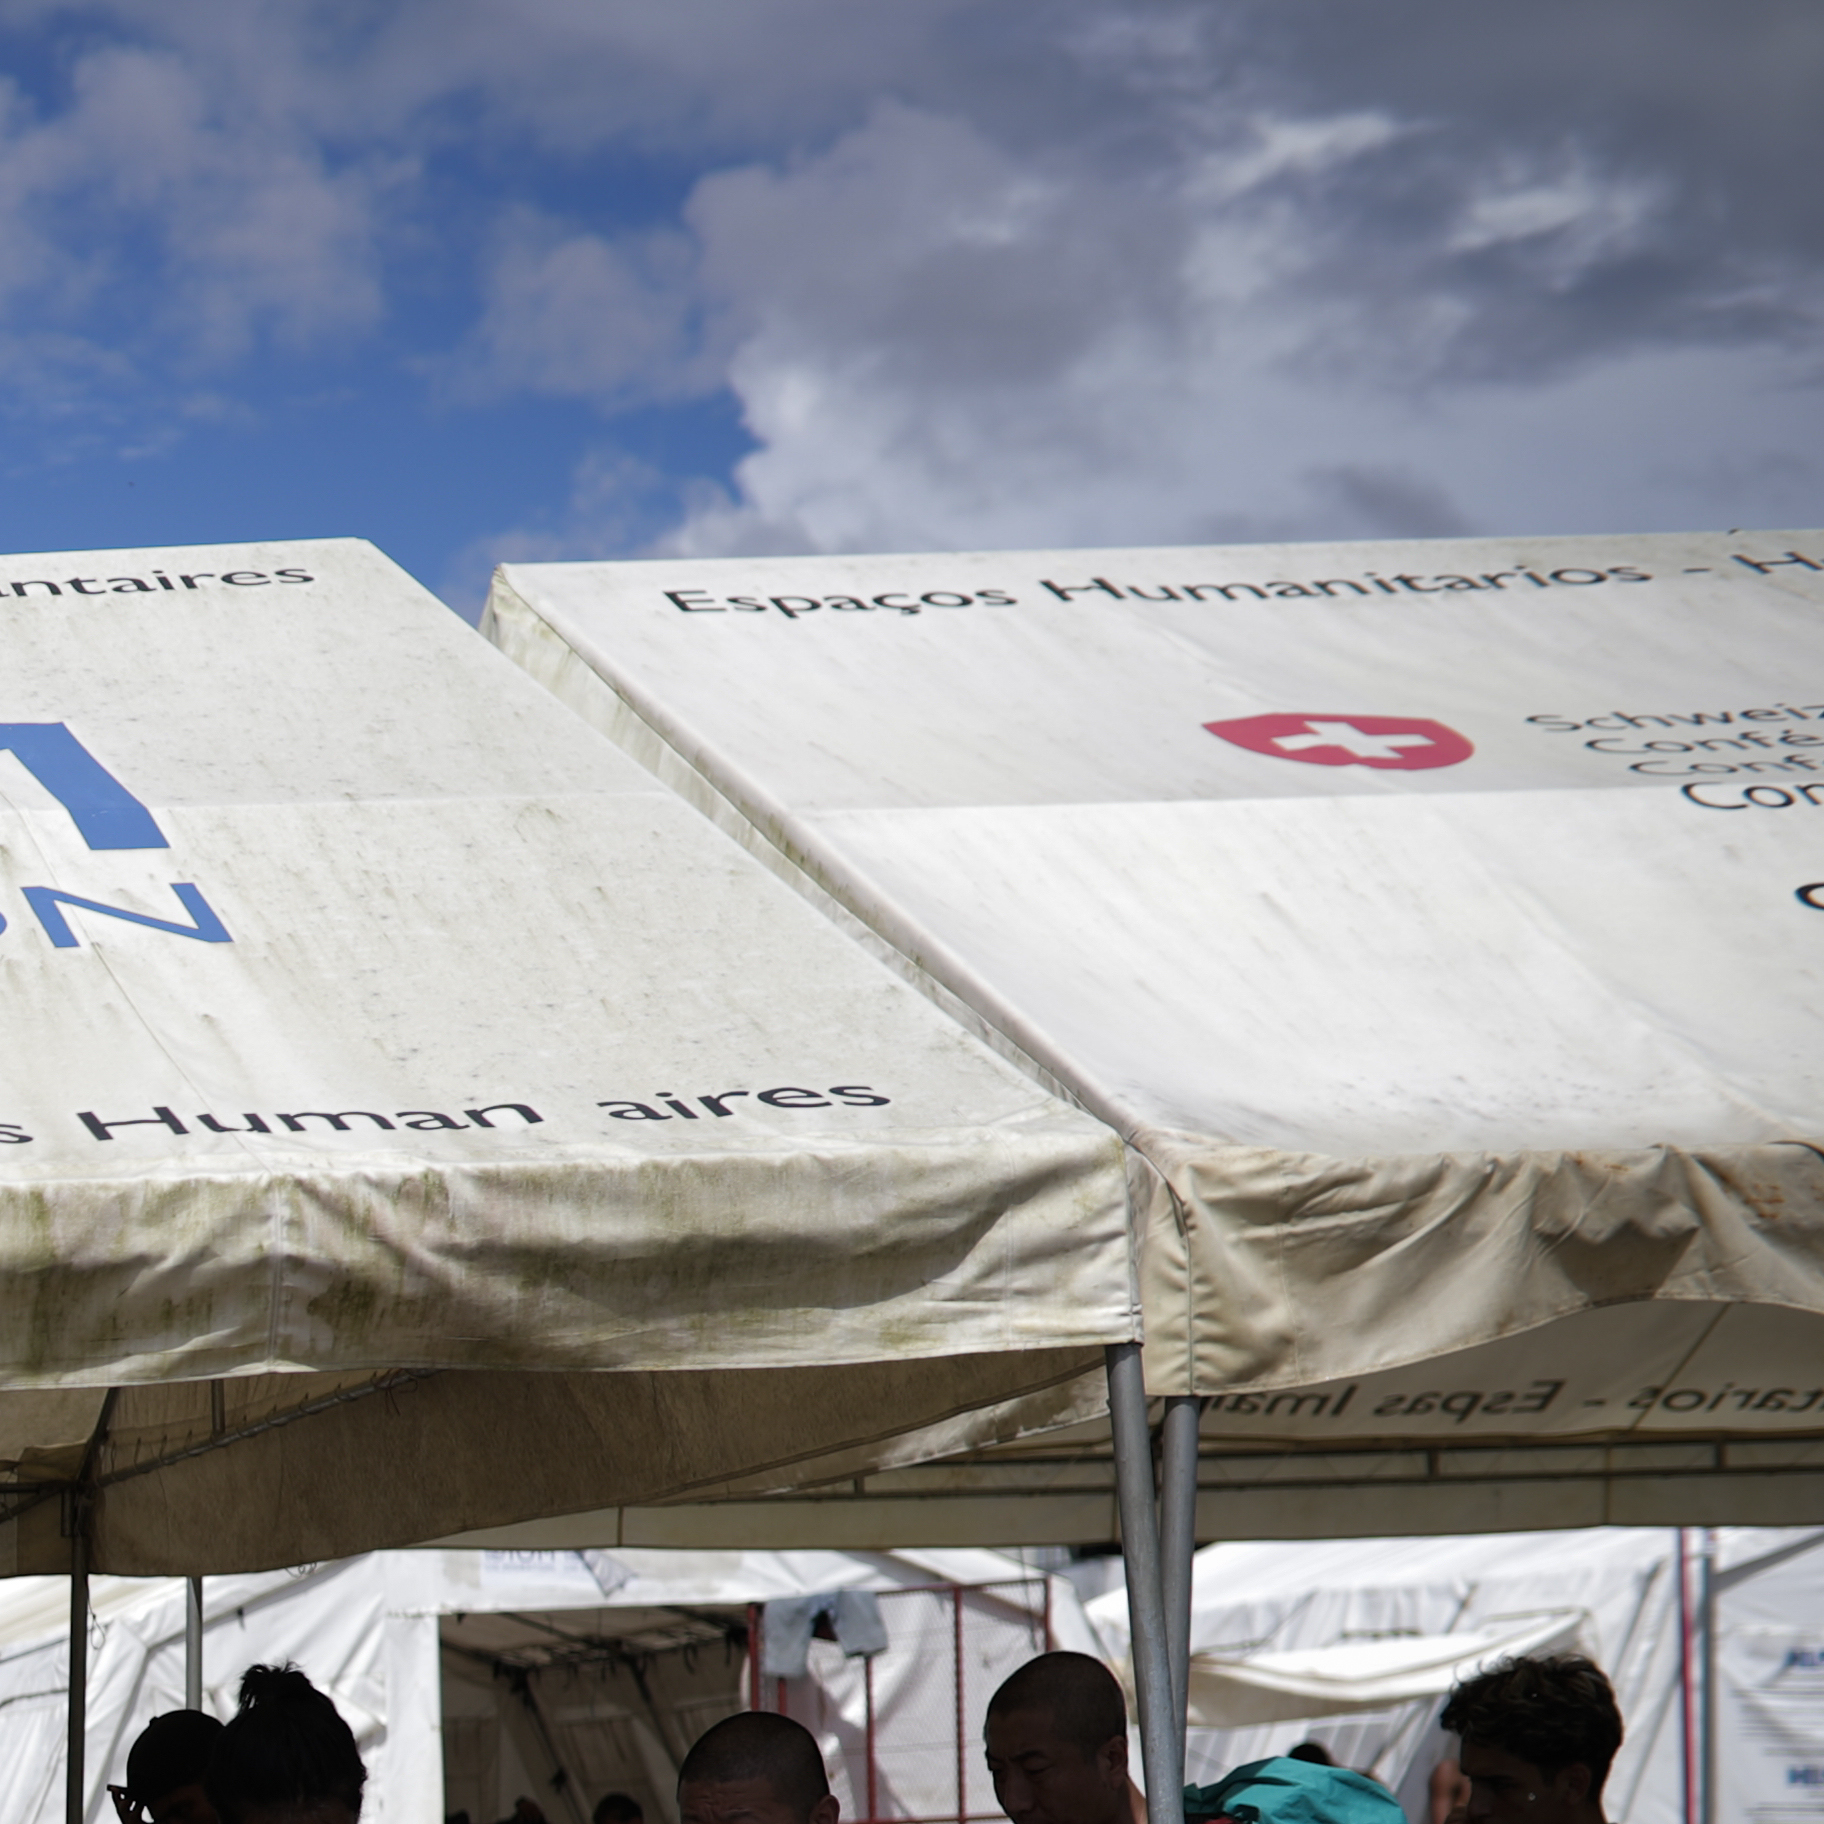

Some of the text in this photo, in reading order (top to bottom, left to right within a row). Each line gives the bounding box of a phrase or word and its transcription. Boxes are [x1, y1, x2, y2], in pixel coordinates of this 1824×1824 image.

[663, 586, 1018, 619] Espaços
[1039, 564, 1653, 602] Humanitarios
[1730, 551, 1824, 575] H
